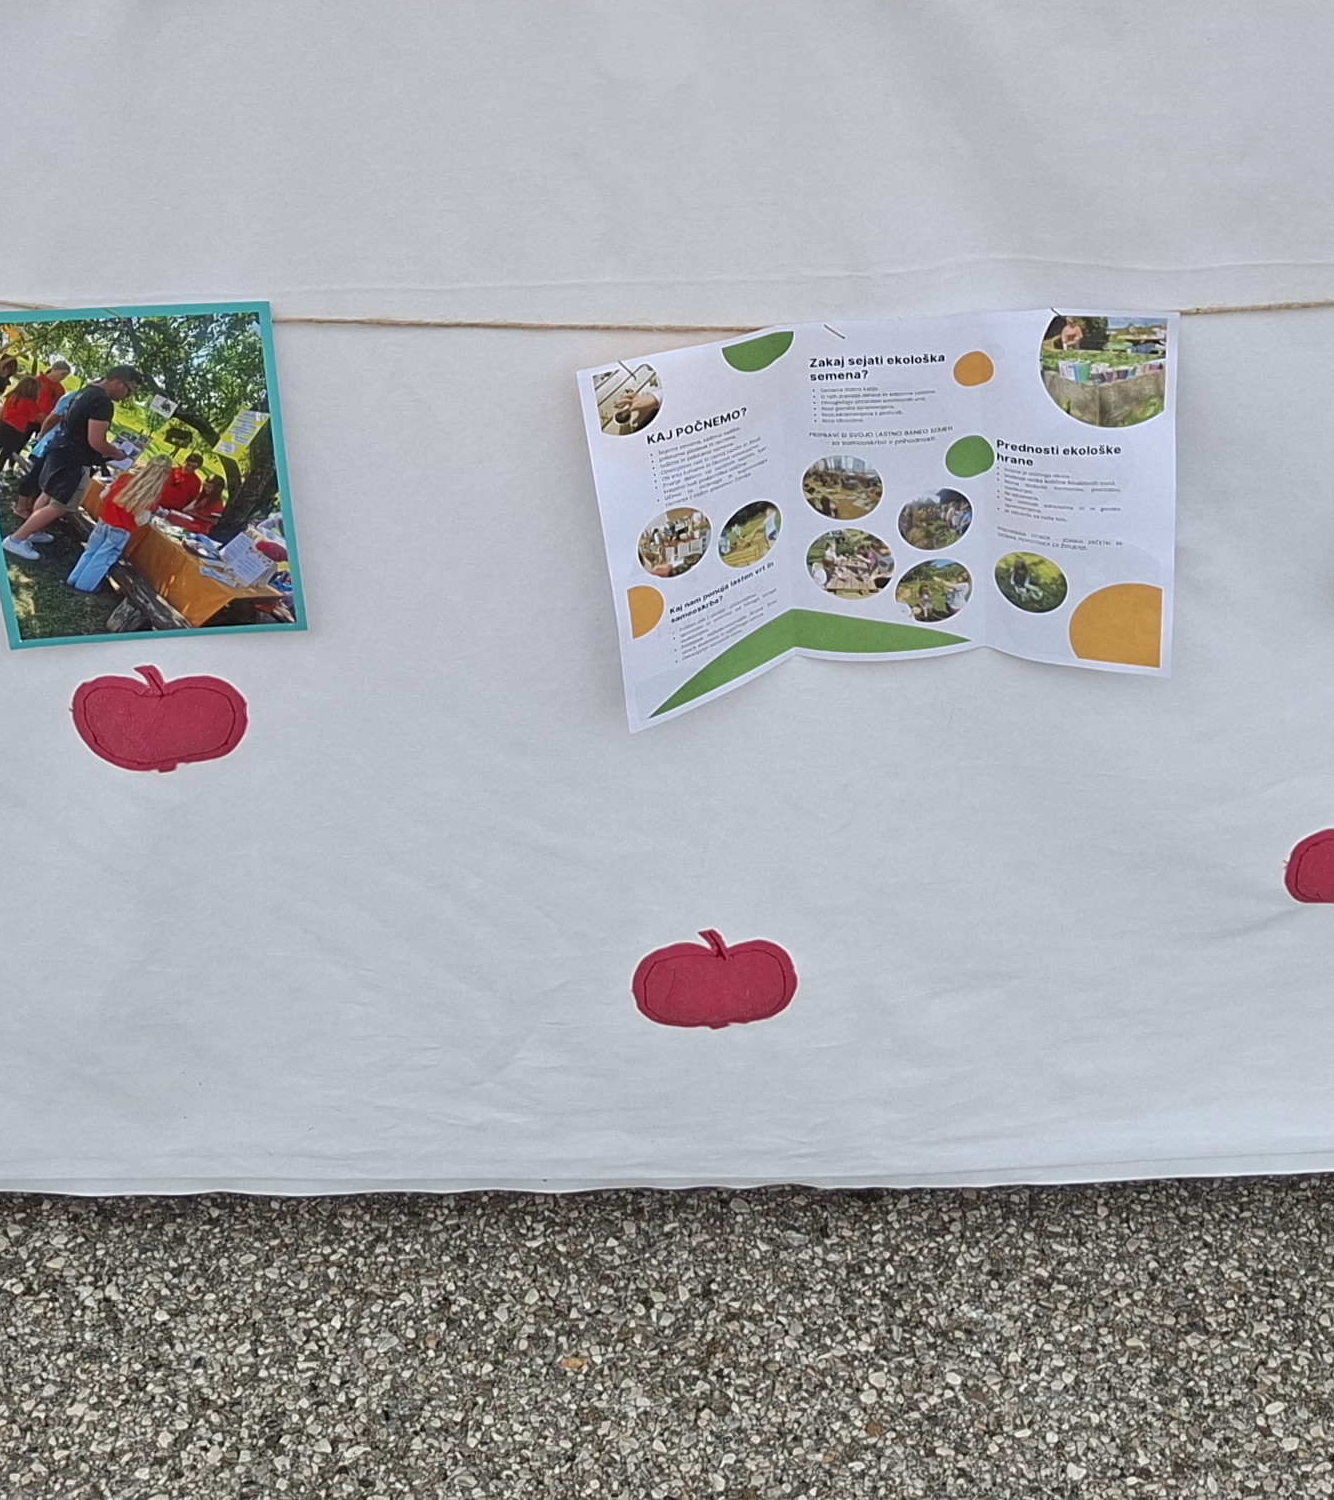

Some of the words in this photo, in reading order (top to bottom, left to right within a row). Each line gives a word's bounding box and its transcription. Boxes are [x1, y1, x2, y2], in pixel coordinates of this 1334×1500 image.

[809, 356, 844, 368] Zakaj
[848, 355, 883, 367] sejati
[887, 353, 945, 365] ekološka
[810, 370, 868, 381] semena?
[647, 430, 673, 445] KAJ
[676, 407, 747, 437] POČNEMO?
[997, 439, 1059, 455] Prednosti
[1063, 445, 1121, 455] ekološke
[997, 452, 1033, 466] hrane
[669, 605, 683, 615] Kaj
[684, 597, 701, 608] nam
[702, 584, 729, 601] ponuja
[730, 572, 753, 587] lasten
[755, 566, 766, 575] vrt
